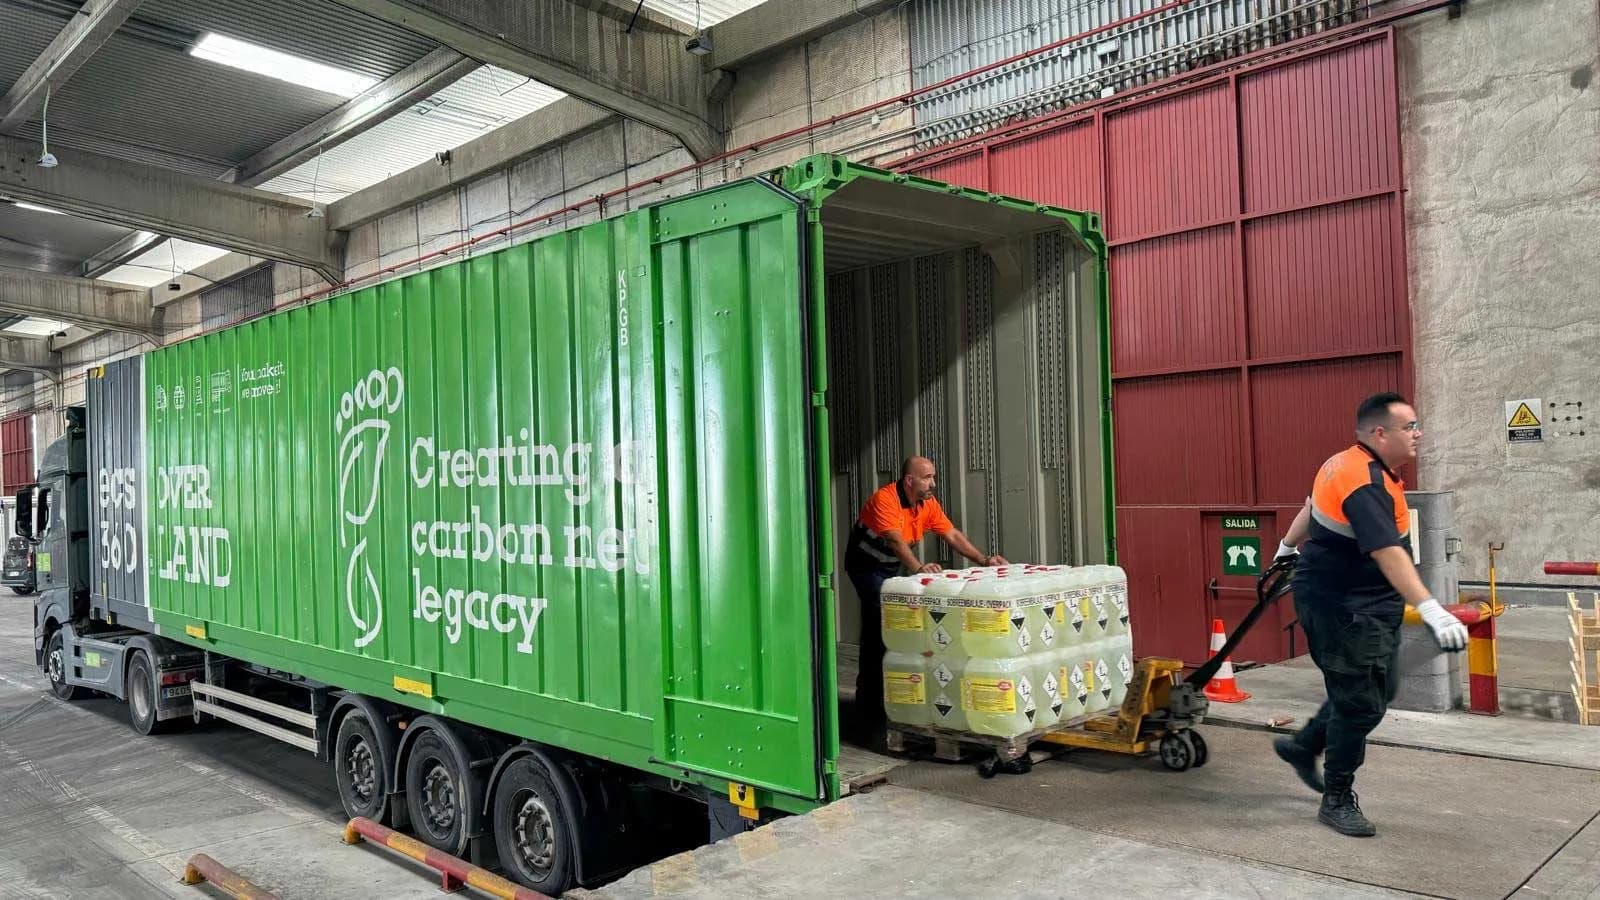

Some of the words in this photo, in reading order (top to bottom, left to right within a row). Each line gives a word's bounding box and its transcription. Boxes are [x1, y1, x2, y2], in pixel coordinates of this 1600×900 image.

[618, 269, 628, 346] KPGB
[99, 467, 136, 510] ecs
[157, 464, 213, 509] OVER
[410, 427, 592, 506] Creating
[100, 520, 137, 574] 360
[411, 505, 553, 566] carbon
[1225, 519, 1257, 528] SALIDA
[158, 525, 232, 588] LAND
[412, 567, 548, 654] legacy
